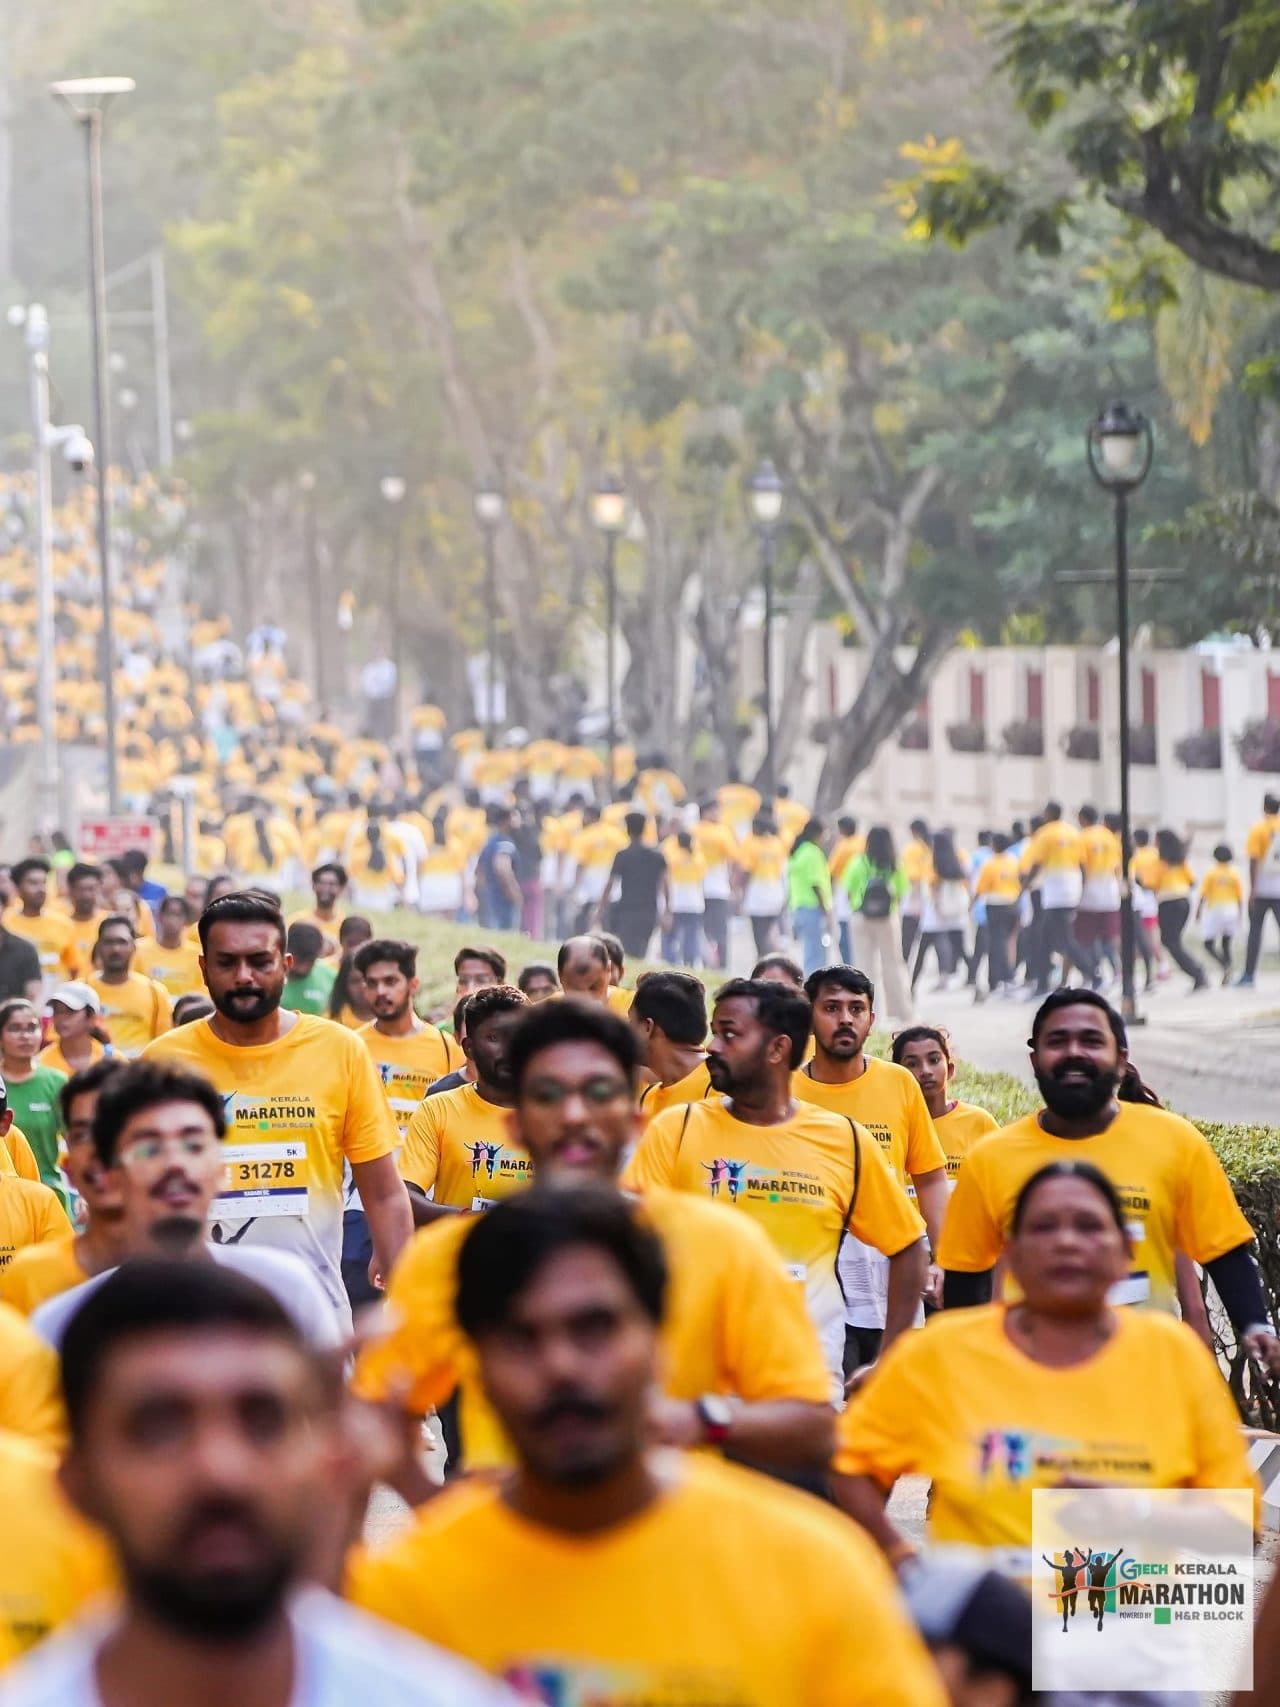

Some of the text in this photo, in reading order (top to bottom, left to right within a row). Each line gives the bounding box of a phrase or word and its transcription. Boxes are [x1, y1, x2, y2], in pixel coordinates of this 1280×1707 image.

[236, 1106, 315, 1121] MARATHON
[240, 1162, 295, 1180] 31278
[748, 1178, 825, 1197] MARATHON
